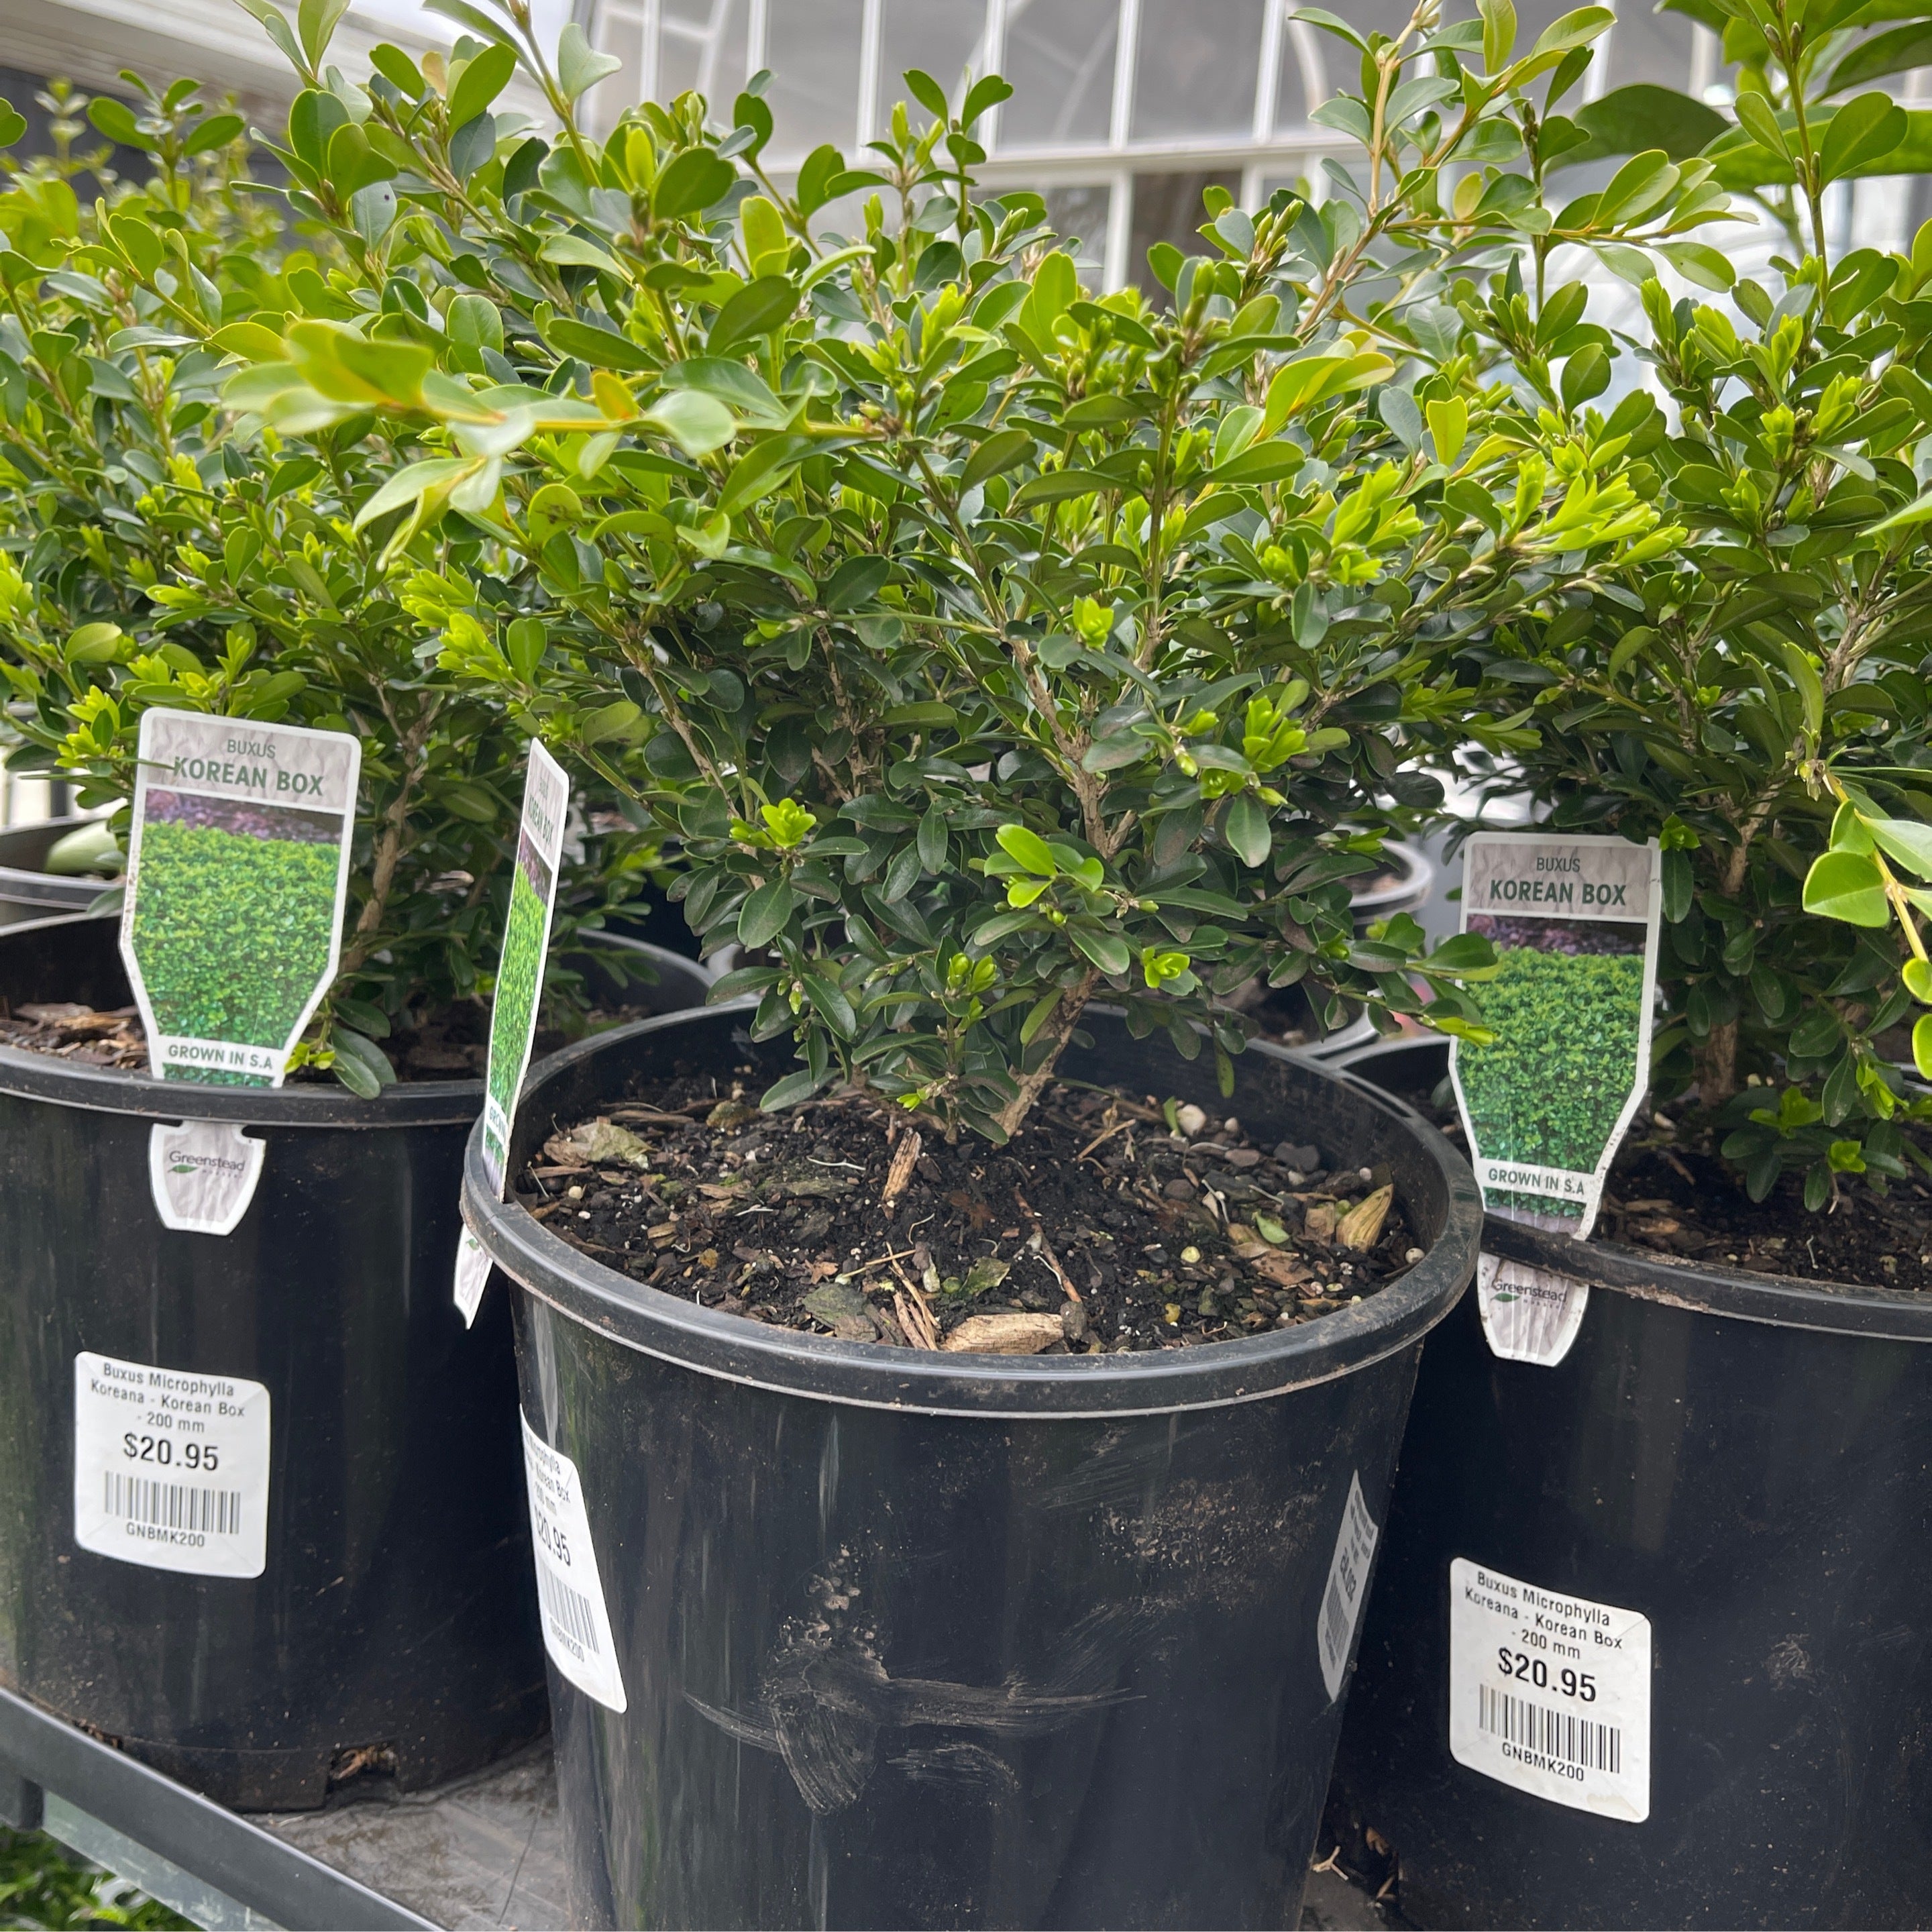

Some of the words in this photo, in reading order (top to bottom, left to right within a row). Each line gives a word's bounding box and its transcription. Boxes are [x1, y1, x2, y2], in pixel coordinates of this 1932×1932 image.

[227, 739, 276, 759] BUXUS
[172, 756, 266, 788] KOREAN
[276, 770, 324, 796] BOX
[1536, 857, 1580, 873] BUXUS
[1490, 879, 1573, 903] KOREAN
[1582, 883, 1627, 906] BOX
[168, 1044, 225, 1062] GROWN
[229, 1051, 245, 1065] IN
[250, 1053, 273, 1070] S.A
[169, 1150, 246, 1172] Greenstead
[1488, 1168, 1542, 1187] GROWN
[1545, 1175, 1559, 1191] IN
[1564, 1179, 1585, 1195] S.A
[1491, 1278, 1568, 1303] Greenstead
[103, 1362, 144, 1384] Buxus
[149, 1373, 235, 1397] Microphylla
[91, 1379, 145, 1403] Koreana
[161, 1395, 212, 1414] Korean
[219, 1402, 246, 1417] Box
[147, 1412, 172, 1429] 200
[178, 1418, 205, 1433] mm
[123, 1432, 219, 1472] $20.95
[127, 1521, 206, 1548] GNBMK200
[1478, 1571, 1517, 1599] Buxus
[1523, 1588, 1611, 1626] Microphylla
[1465, 1587, 1519, 1619] Koreana
[1535, 1613, 1587, 1641] Korean
[1595, 1631, 1623, 1649] Box
[1521, 1629, 1548, 1650] 200
[1553, 1642, 1580, 1660] mm
[1497, 1646, 1597, 1702] $20.95
[1502, 1742, 1585, 1782] GNBMK200
